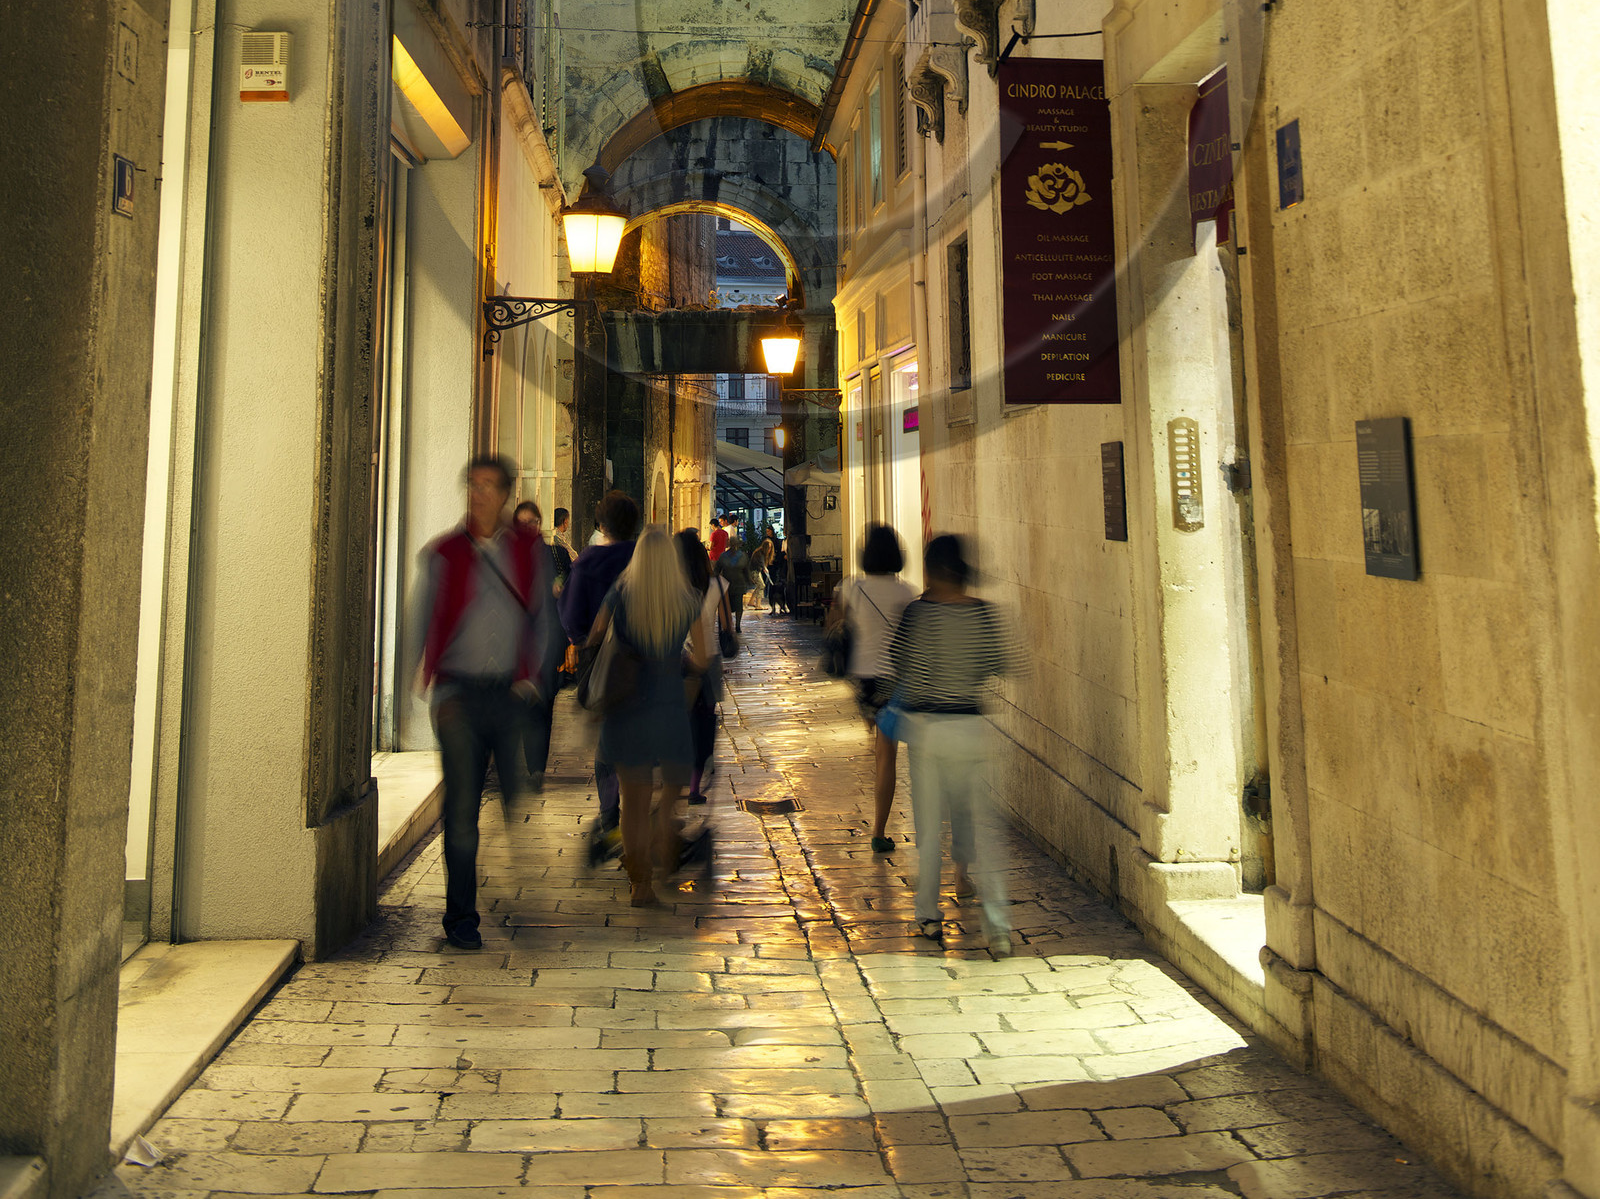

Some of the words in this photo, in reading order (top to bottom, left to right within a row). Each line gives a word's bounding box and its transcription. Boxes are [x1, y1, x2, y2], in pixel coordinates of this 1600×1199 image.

[1007, 83, 1057, 99] CINDRO
[1060, 85, 1104, 100] PALACE
[1037, 108, 1075, 116] MASSAGE
[1026, 124, 1057, 132] BEAUTY
[1058, 125, 1088, 133] STUDIO
[1036, 234, 1050, 242] OIL
[1052, 235, 1089, 243] MASSAGE
[1015, 254, 1074, 262] ANTICELLULITE
[1075, 254, 1113, 262] MASSAGE
[1031, 273, 1053, 281] FOOT
[1054, 273, 1093, 281] MASSAGE
[1032, 293, 1053, 302] THAI
[1055, 294, 1093, 302] MASSAGE
[1051, 313, 1076, 321] NAILS
[1041, 333, 1087, 341] MANICURE
[1041, 353, 1090, 361] DEPILATION
[1046, 373, 1086, 381] PEDICURE
